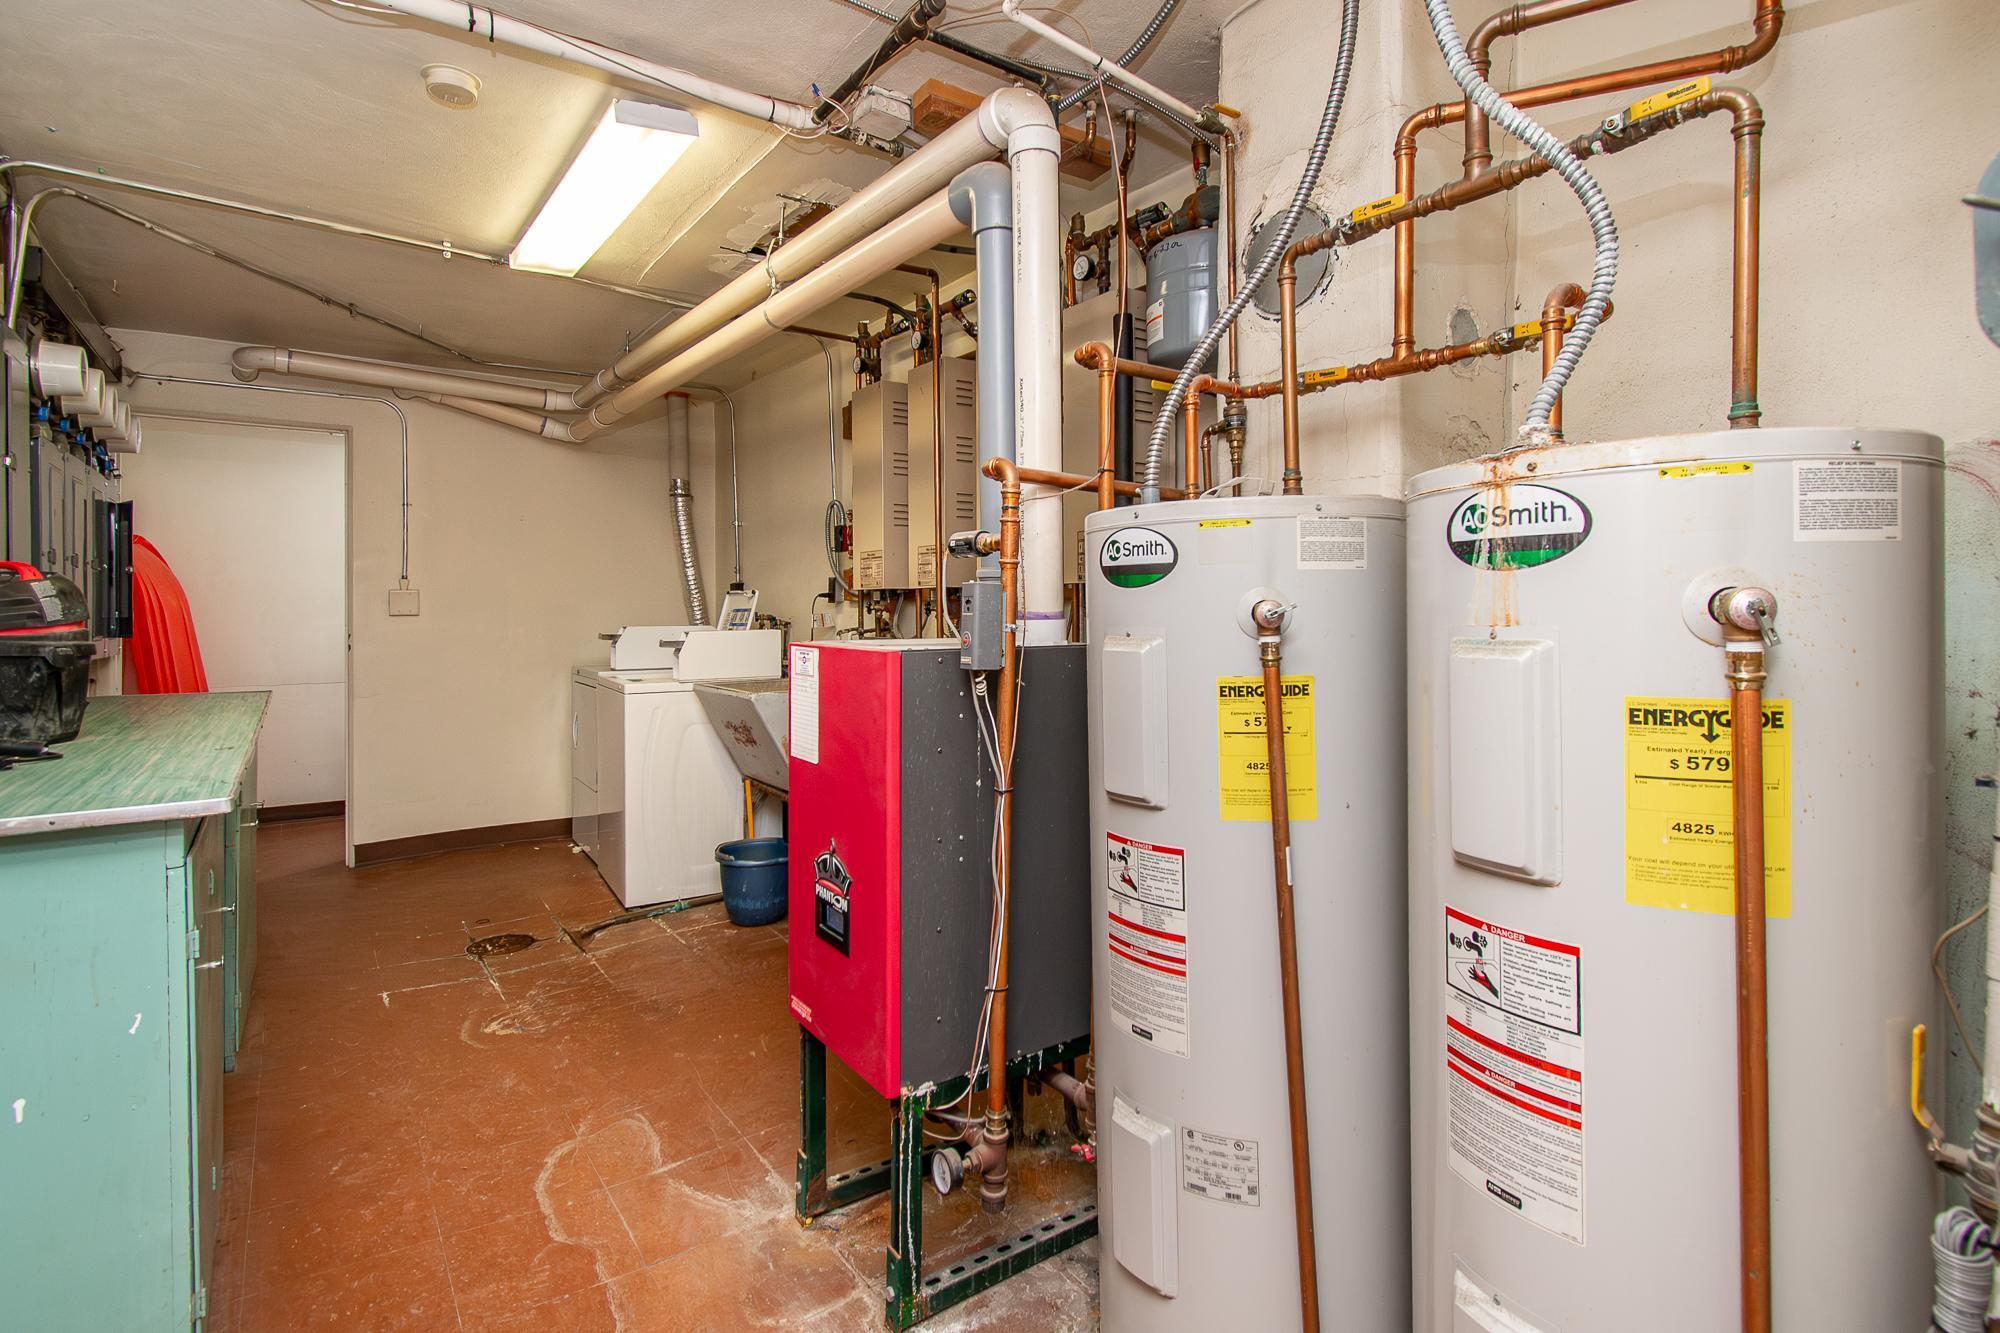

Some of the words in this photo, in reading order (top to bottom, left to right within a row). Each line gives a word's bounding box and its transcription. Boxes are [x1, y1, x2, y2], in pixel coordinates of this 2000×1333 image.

[1219, 684, 1310, 697] ENERGUIDE
[1629, 708, 1784, 732] ENERGYGDE
[1685, 747, 1707, 755] Yearly
[1670, 759, 1679, 770] $
[1687, 756, 1730, 771] 579
[1672, 822, 1714, 835] 4825
[815, 883, 848, 913] PHANTOM
[1490, 926, 1526, 943] DANGER
[1491, 1072, 1516, 1088] DANGER
